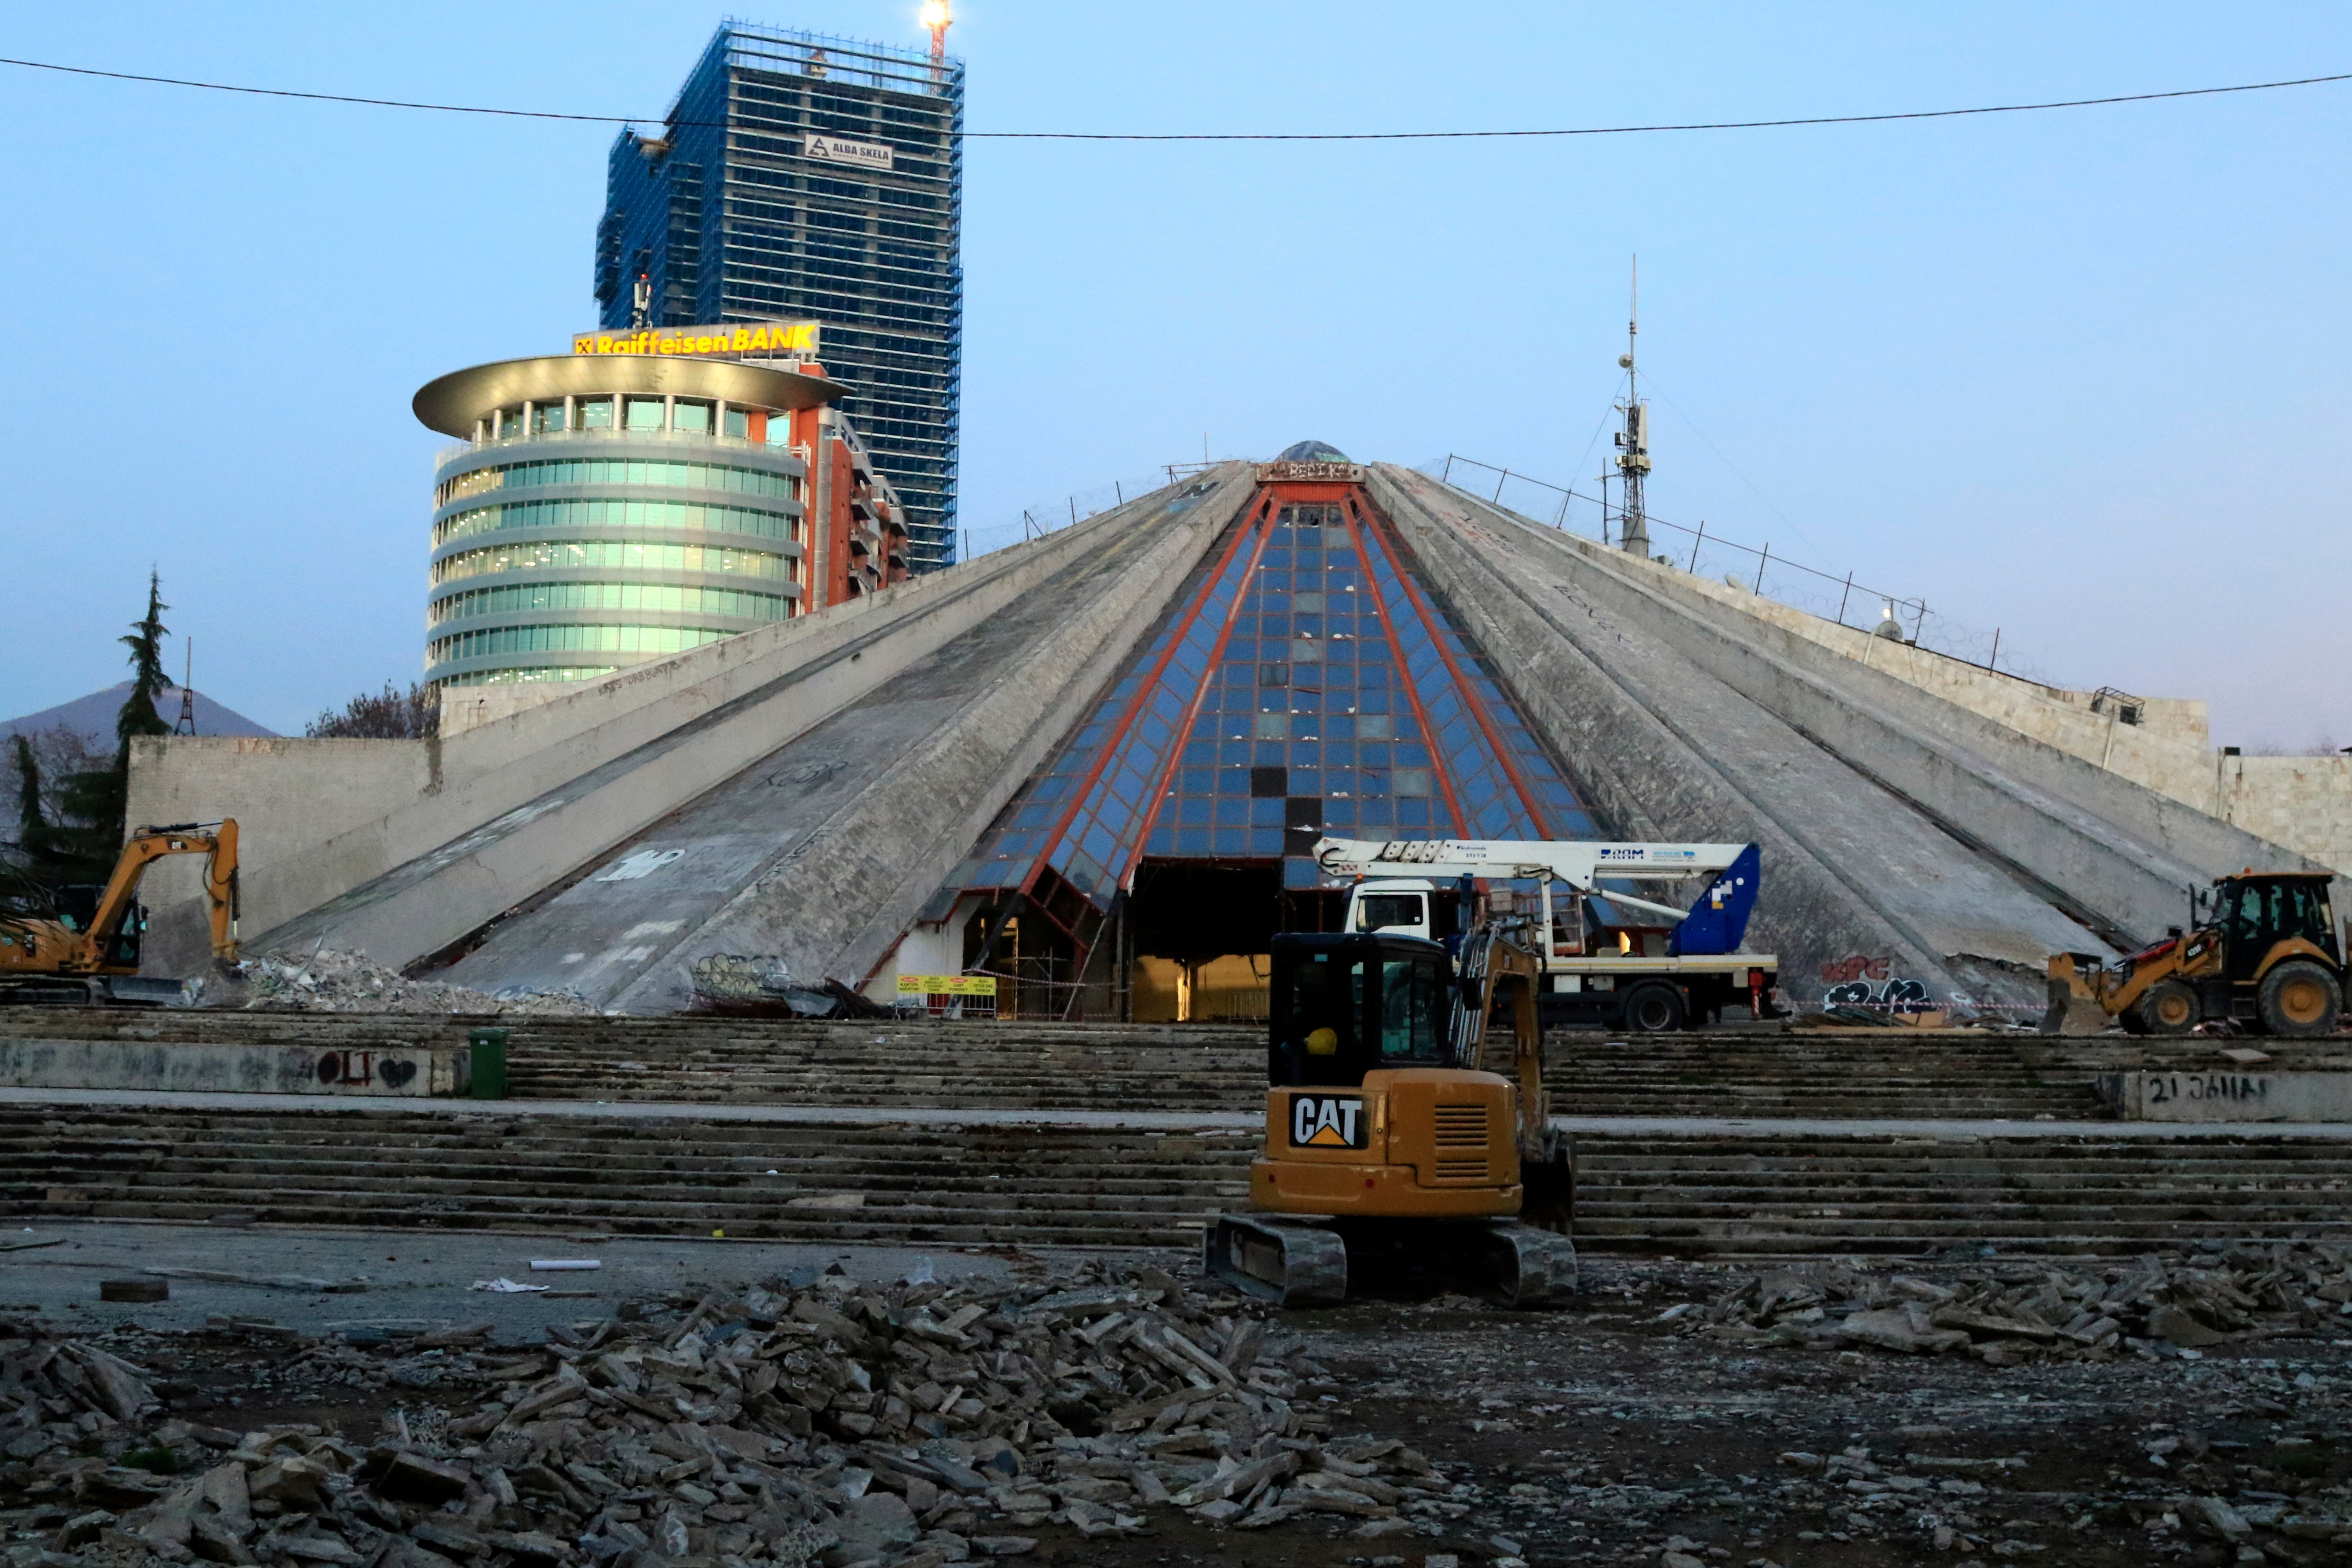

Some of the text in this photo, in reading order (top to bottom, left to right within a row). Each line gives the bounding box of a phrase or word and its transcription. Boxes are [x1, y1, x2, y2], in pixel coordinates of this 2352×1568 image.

[833, 143, 857, 155] ALBA
[860, 147, 889, 159] SKELA
[597, 325, 815, 355] Raiffeisen BANK
[1613, 849, 1644, 859] RAM
[1295, 1098, 1362, 1145] CAT
